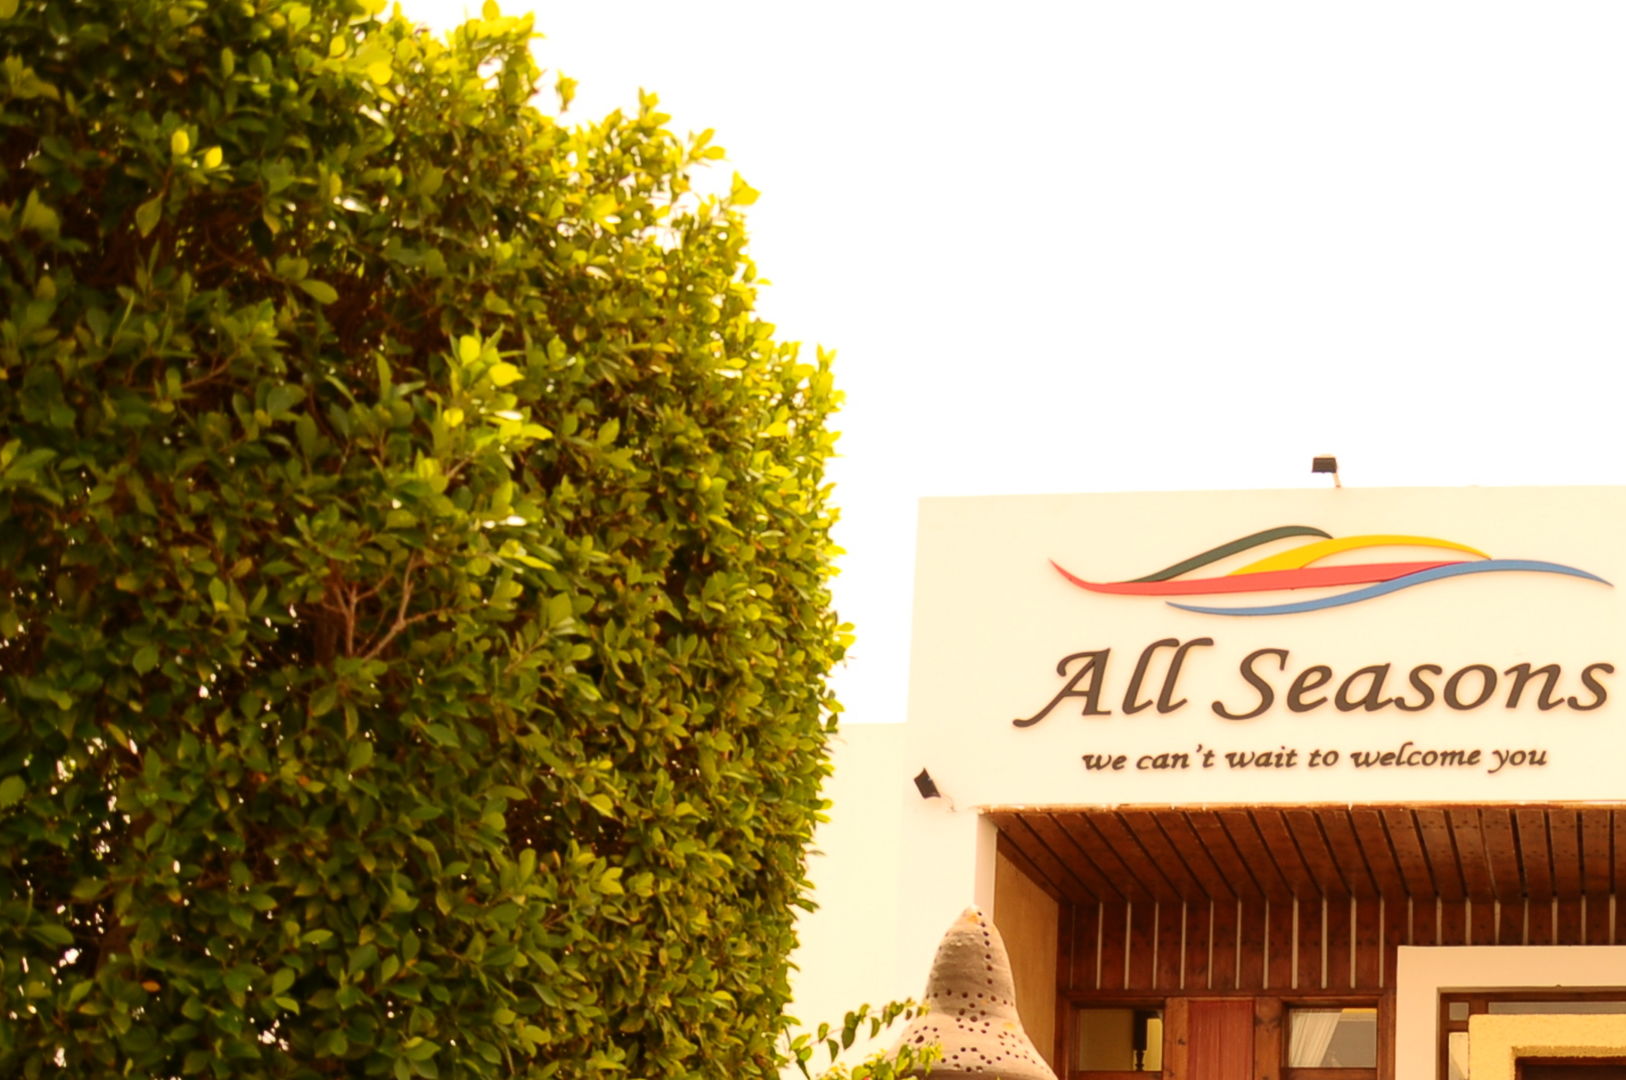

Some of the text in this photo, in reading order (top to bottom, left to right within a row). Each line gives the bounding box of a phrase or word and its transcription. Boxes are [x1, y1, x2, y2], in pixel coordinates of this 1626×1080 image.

[1012, 637, 1615, 728] All Seasons
[1081, 741, 1547, 775] we can't wait to welcome you
